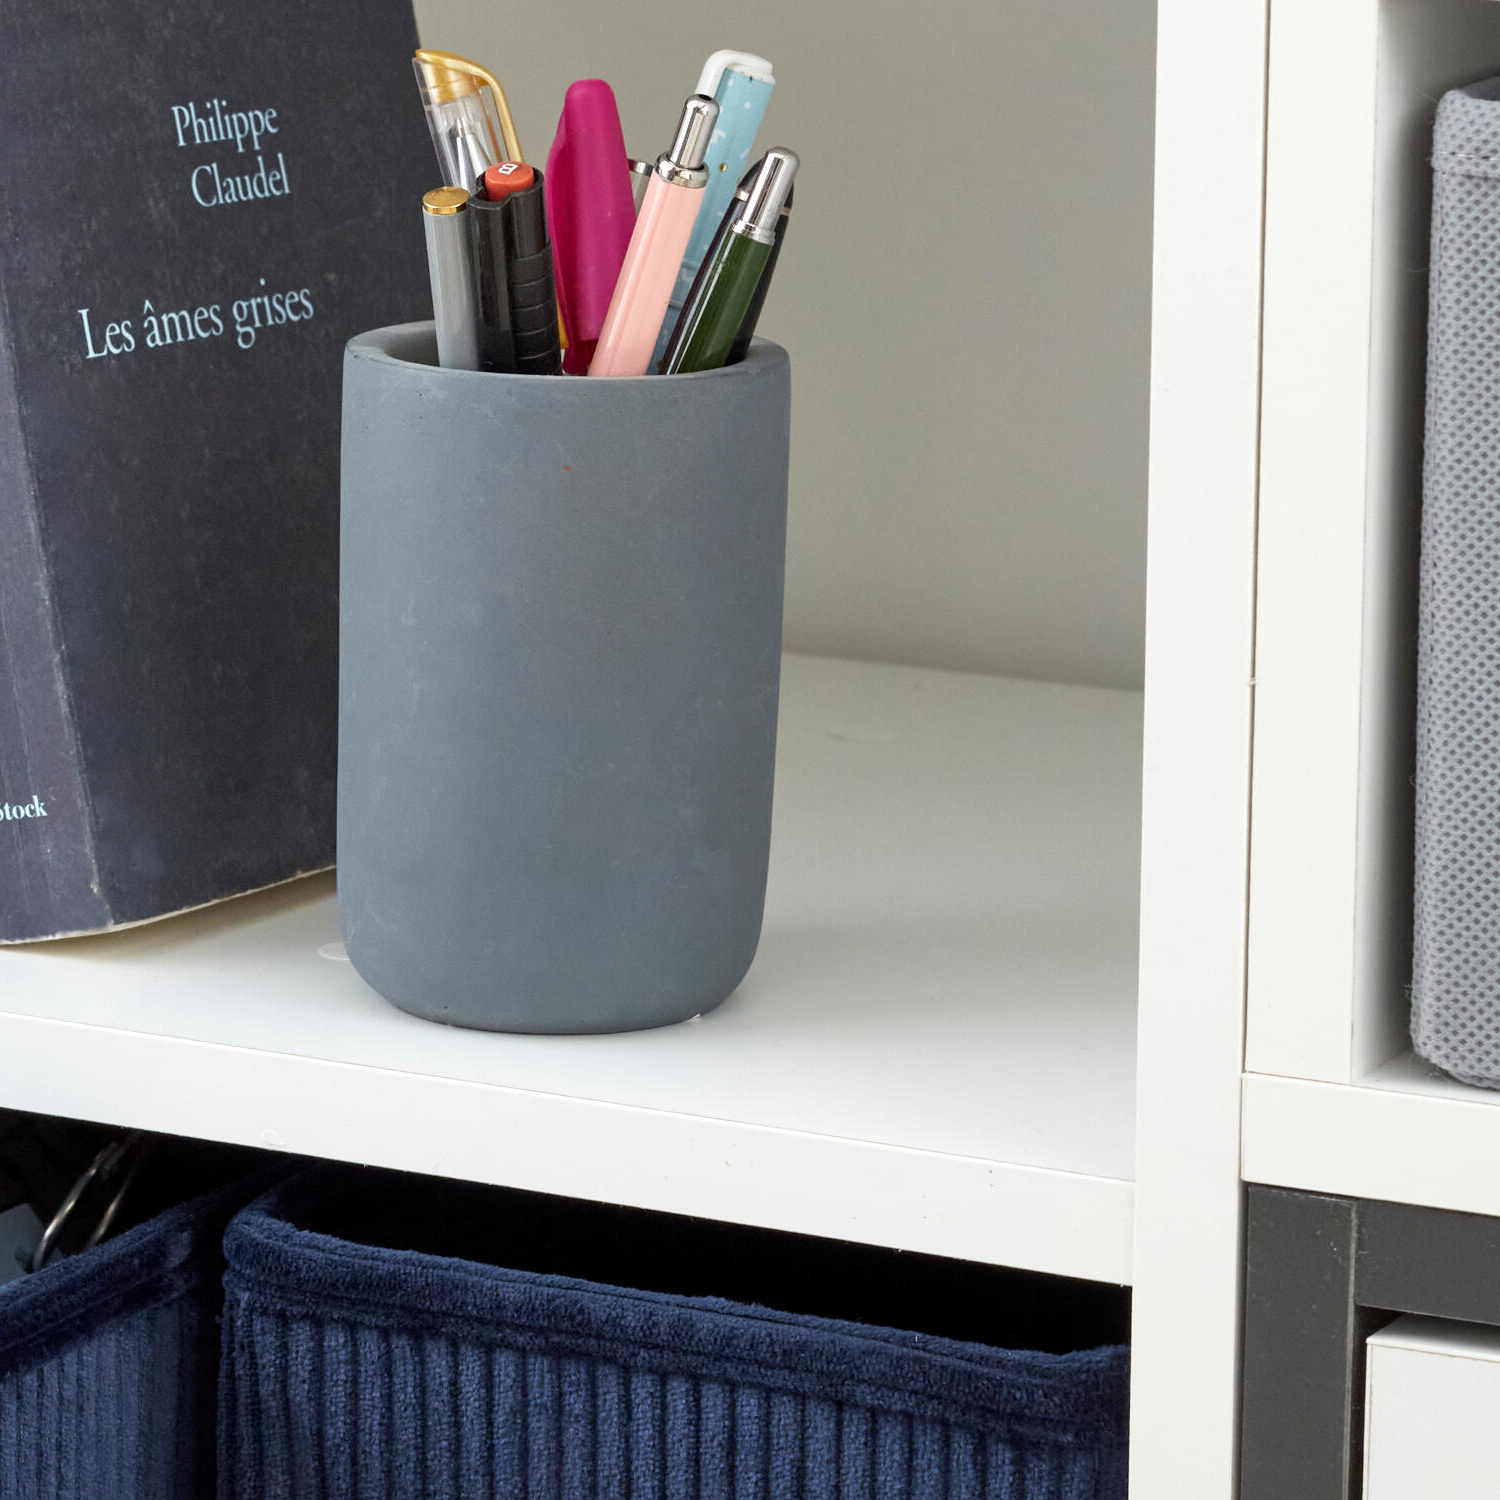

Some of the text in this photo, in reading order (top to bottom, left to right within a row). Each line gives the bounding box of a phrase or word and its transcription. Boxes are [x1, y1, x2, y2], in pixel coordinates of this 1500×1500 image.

[172, 99, 278, 153] Philippe
[191, 153, 290, 207] Claudel
[78, 278, 315, 359] Les âmes grises
